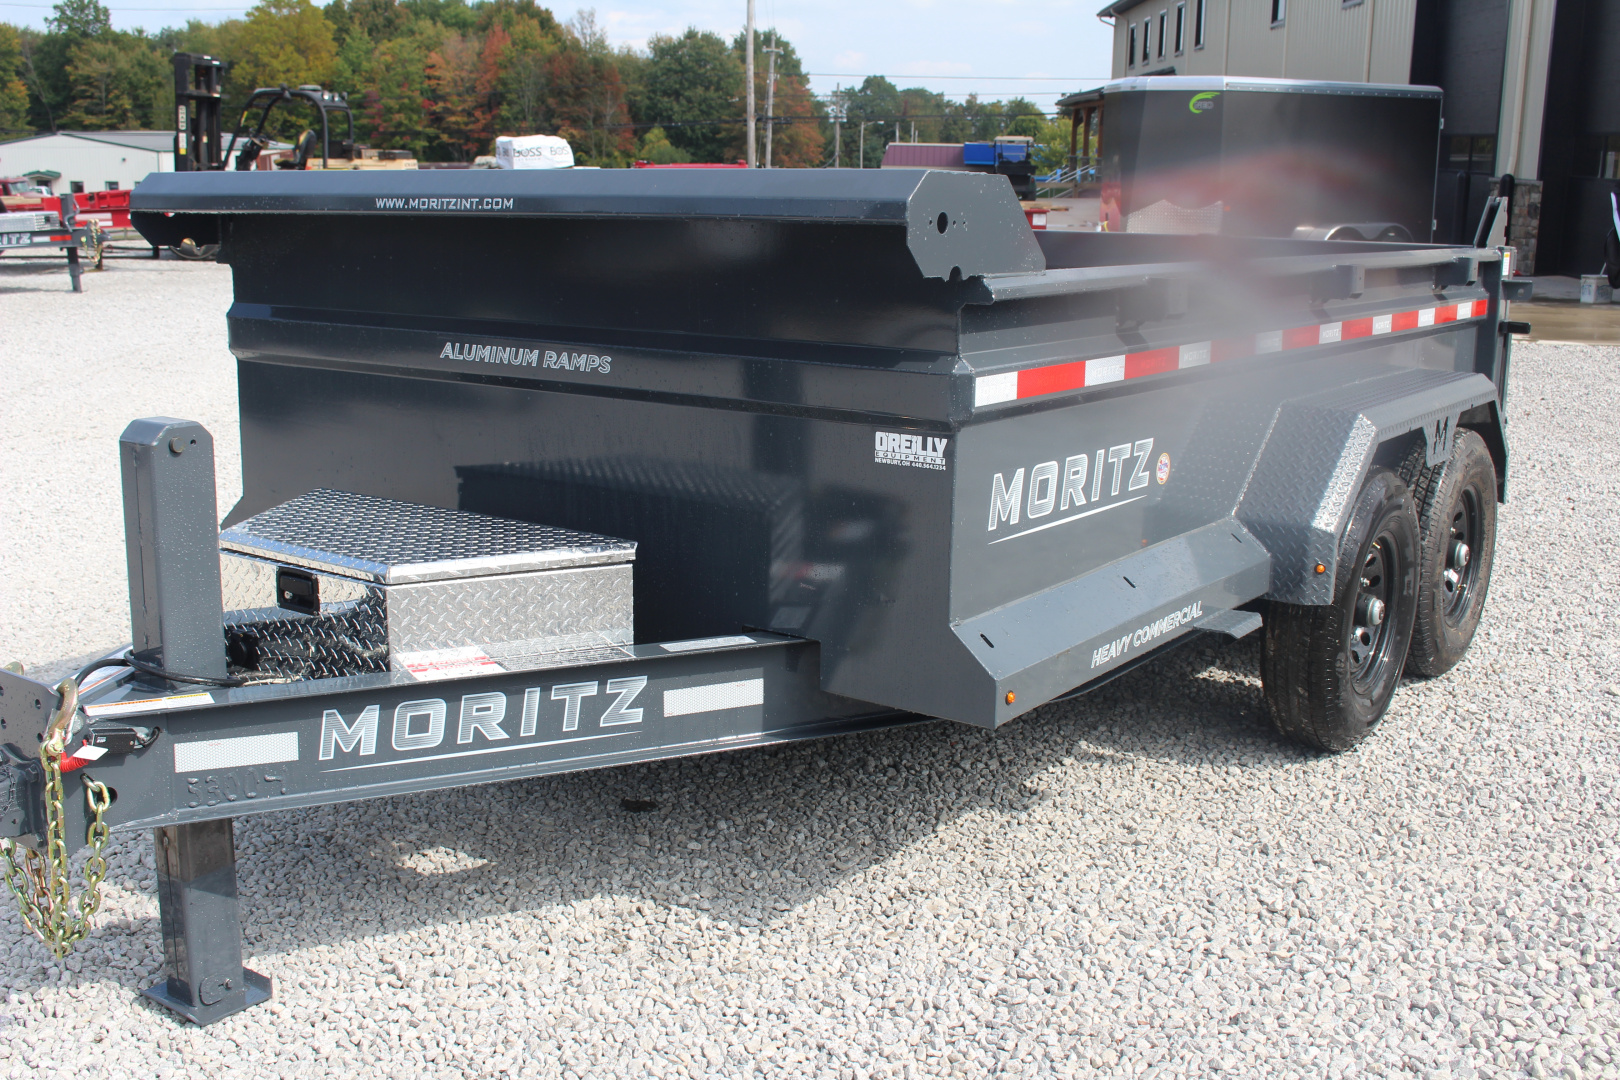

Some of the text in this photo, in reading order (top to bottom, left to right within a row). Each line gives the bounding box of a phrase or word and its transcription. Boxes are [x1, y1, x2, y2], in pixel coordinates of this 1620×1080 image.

[513, 147, 542, 157] BOSS
[376, 198, 514, 209] WWW.MORITZINT.COM
[0, 233, 31, 245] ITZ
[440, 342, 613, 374] ALUMINUM RAMPS
[875, 450, 945, 464] EQUIPMENT
[988, 437, 1154, 531] MORITZ
[1091, 600, 1203, 669] HEAVY COMMERCIAL
[318, 676, 648, 760] MORITZ
